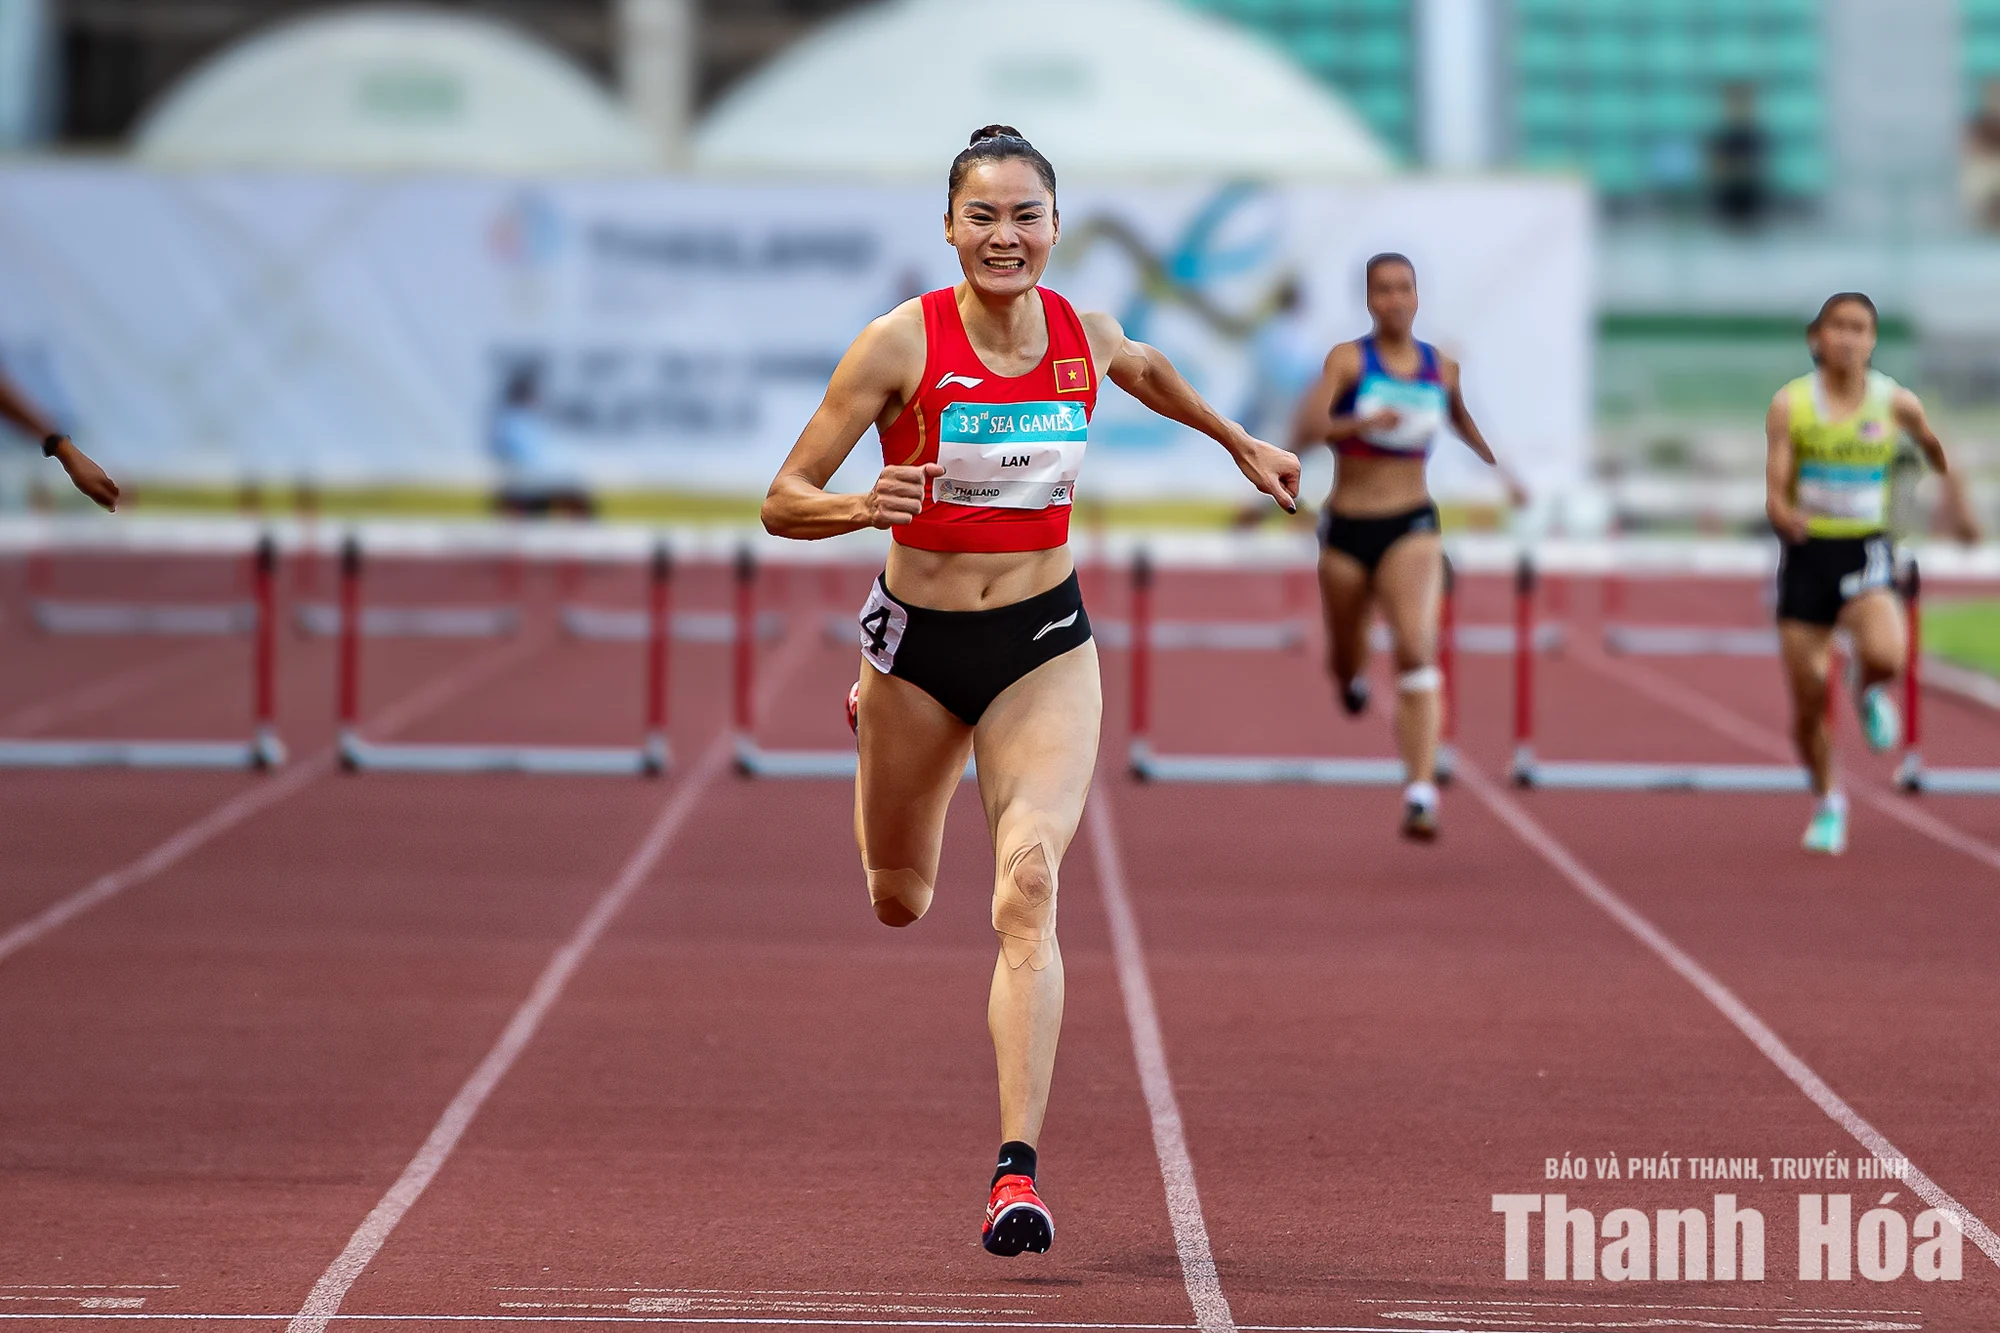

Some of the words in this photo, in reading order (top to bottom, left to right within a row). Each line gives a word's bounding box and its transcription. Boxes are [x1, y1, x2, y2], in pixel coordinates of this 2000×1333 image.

[989, 415, 1015, 433] SEA
[1019, 413, 1074, 433] GAMES
[1001, 455, 1030, 467] LAN
[954, 487, 1000, 497] THAILAND
[1051, 487, 1066, 498] 56
[861, 605, 891, 657] 4
